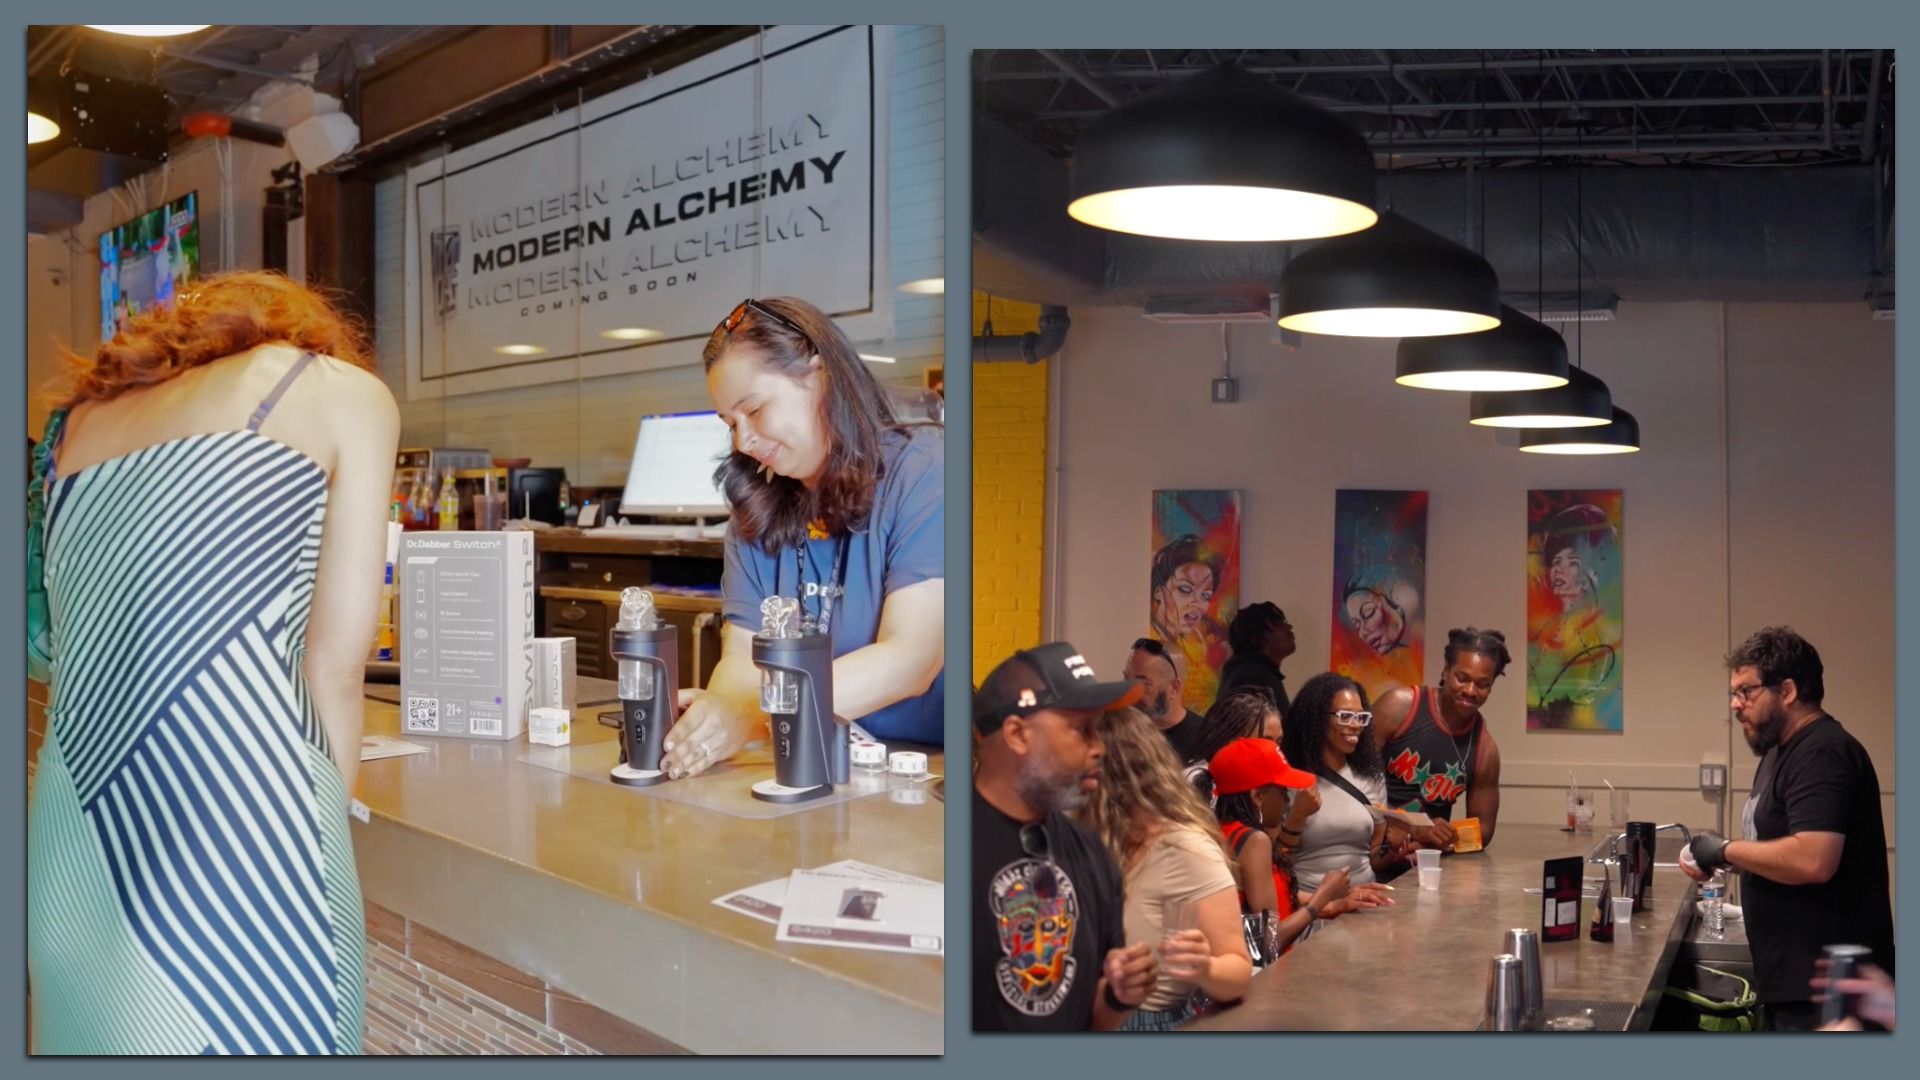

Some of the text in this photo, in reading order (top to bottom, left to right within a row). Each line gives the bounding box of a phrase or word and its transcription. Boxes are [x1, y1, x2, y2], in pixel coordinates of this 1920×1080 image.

[471, 112, 831, 242] MODERN ALCHEMY
[473, 217, 611, 275] MODERN
[625, 150, 848, 236] ALCHEMY
[468, 255, 609, 309] MODERN
[620, 205, 831, 277] ALCHEMY
[520, 271, 697, 317] COMING SOON
[445, 703, 463, 717] 21+
